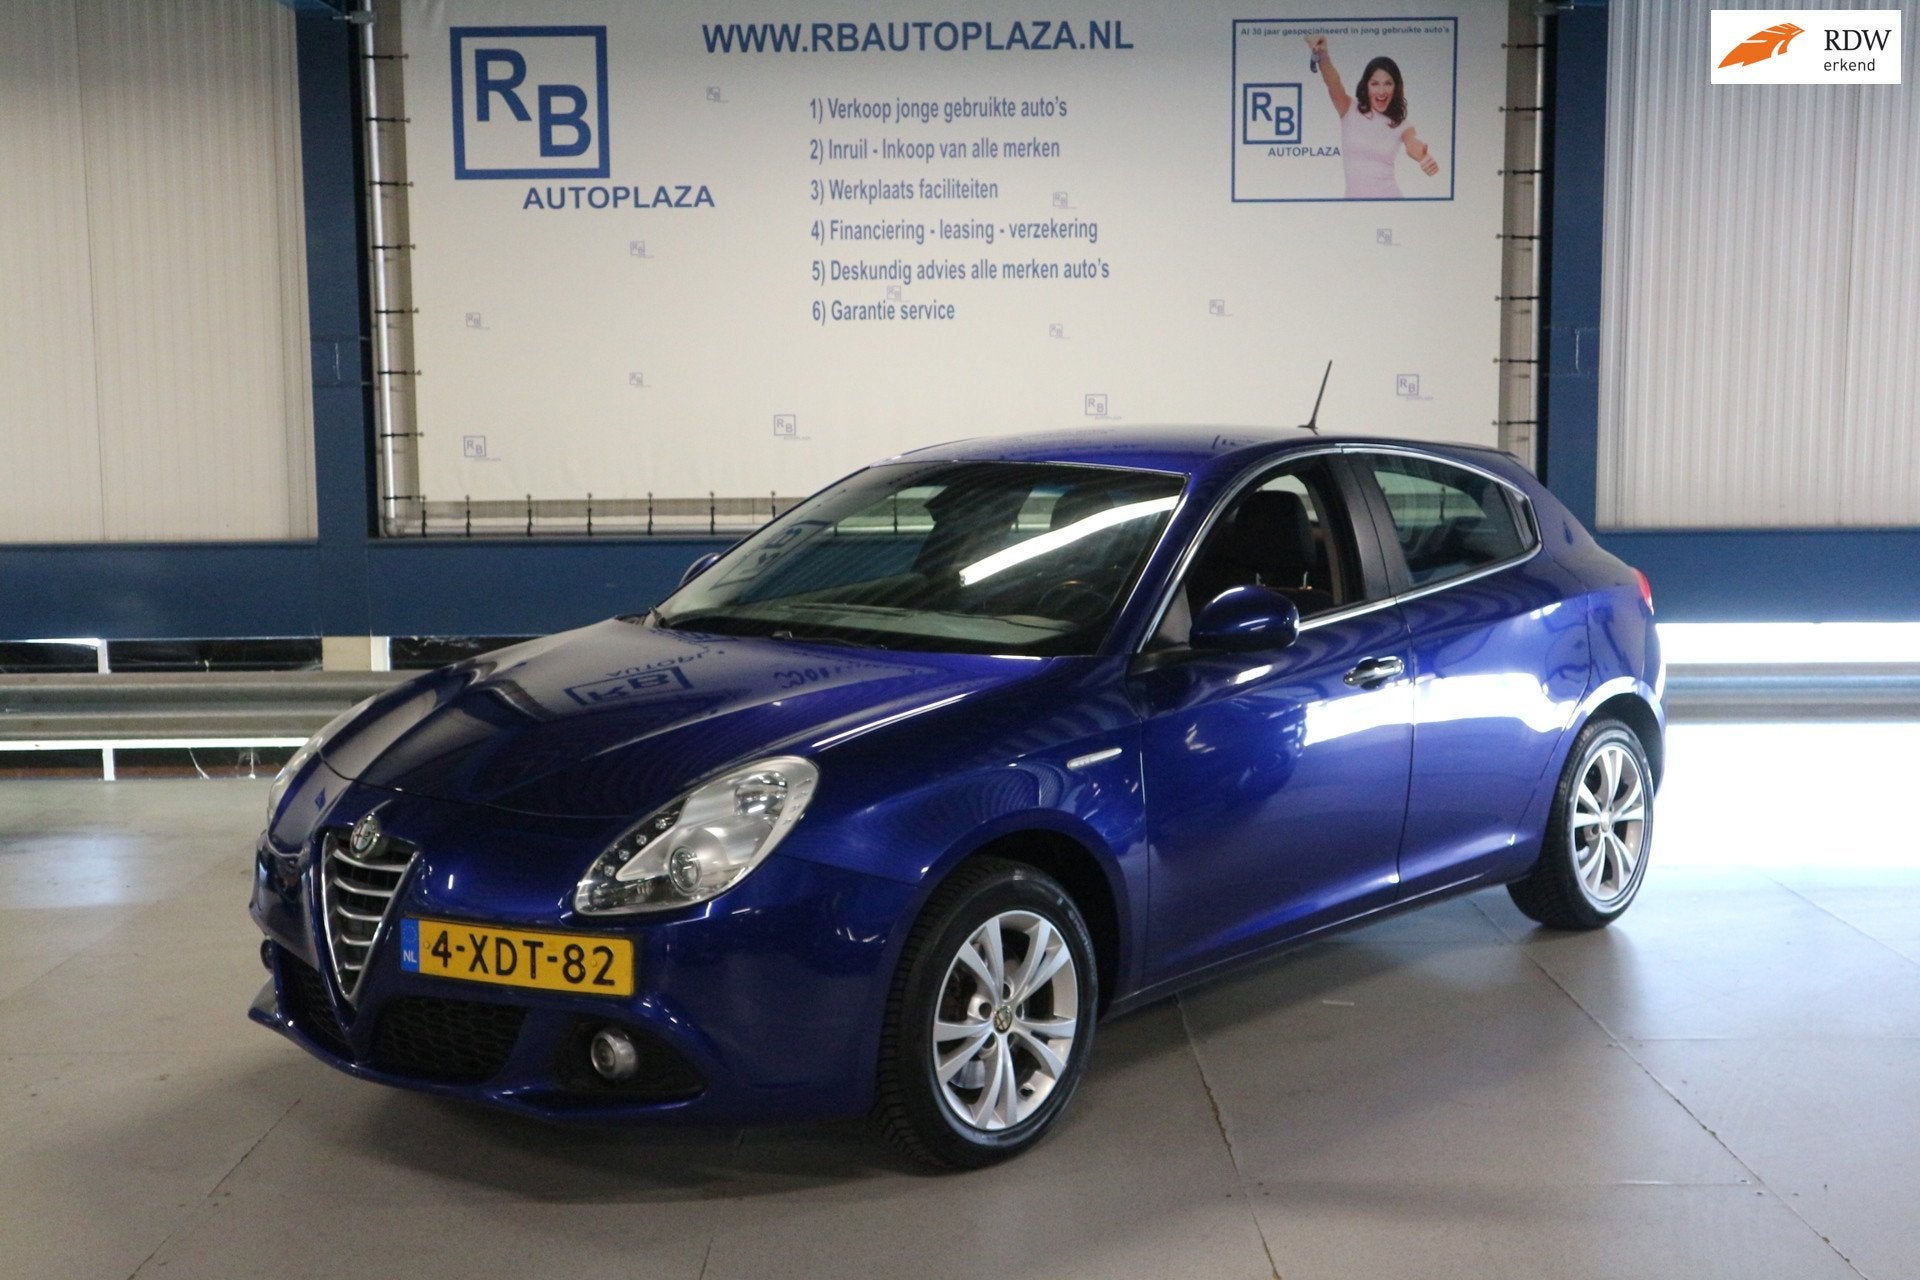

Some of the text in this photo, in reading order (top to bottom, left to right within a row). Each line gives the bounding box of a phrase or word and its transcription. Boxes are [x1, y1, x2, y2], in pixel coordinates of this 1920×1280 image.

[702, 20, 1134, 53] WWW.RBAUTOPLAZA.NL
[1264, 28, 1280, 37] jaar
[1282, 27, 1348, 37] gespecialiseerd
[1382, 26, 1422, 36] gebruikte
[474, 48, 592, 157] RB
[809, 96, 1067, 125] 1) Verkoop jonge gebruikte auto's
[1252, 91, 1295, 136] RB
[809, 138, 824, 165] 2)
[828, 138, 868, 160] Inruil
[882, 138, 935, 164] Inkoop
[939, 141, 967, 158] van
[971, 136, 999, 158] alle
[1003, 136, 1061, 158] merken
[1267, 147, 1341, 157] AUTOPLAZA
[522, 185, 716, 210] AUTOPLAZA
[810, 178, 999, 206] 3) Werkplaats faciliteiten
[811, 219, 825, 246] 4)
[830, 218, 925, 245] Financiering
[939, 218, 995, 245] leasing
[1008, 218, 1098, 244] verzekering
[812, 257, 1110, 287] 5) Deskundig advies alle merken auto's
[812, 299, 956, 327] 6) Garantie service
[402, 950, 418, 964] NL
[431, 929, 616, 987] 4-XDT-82
